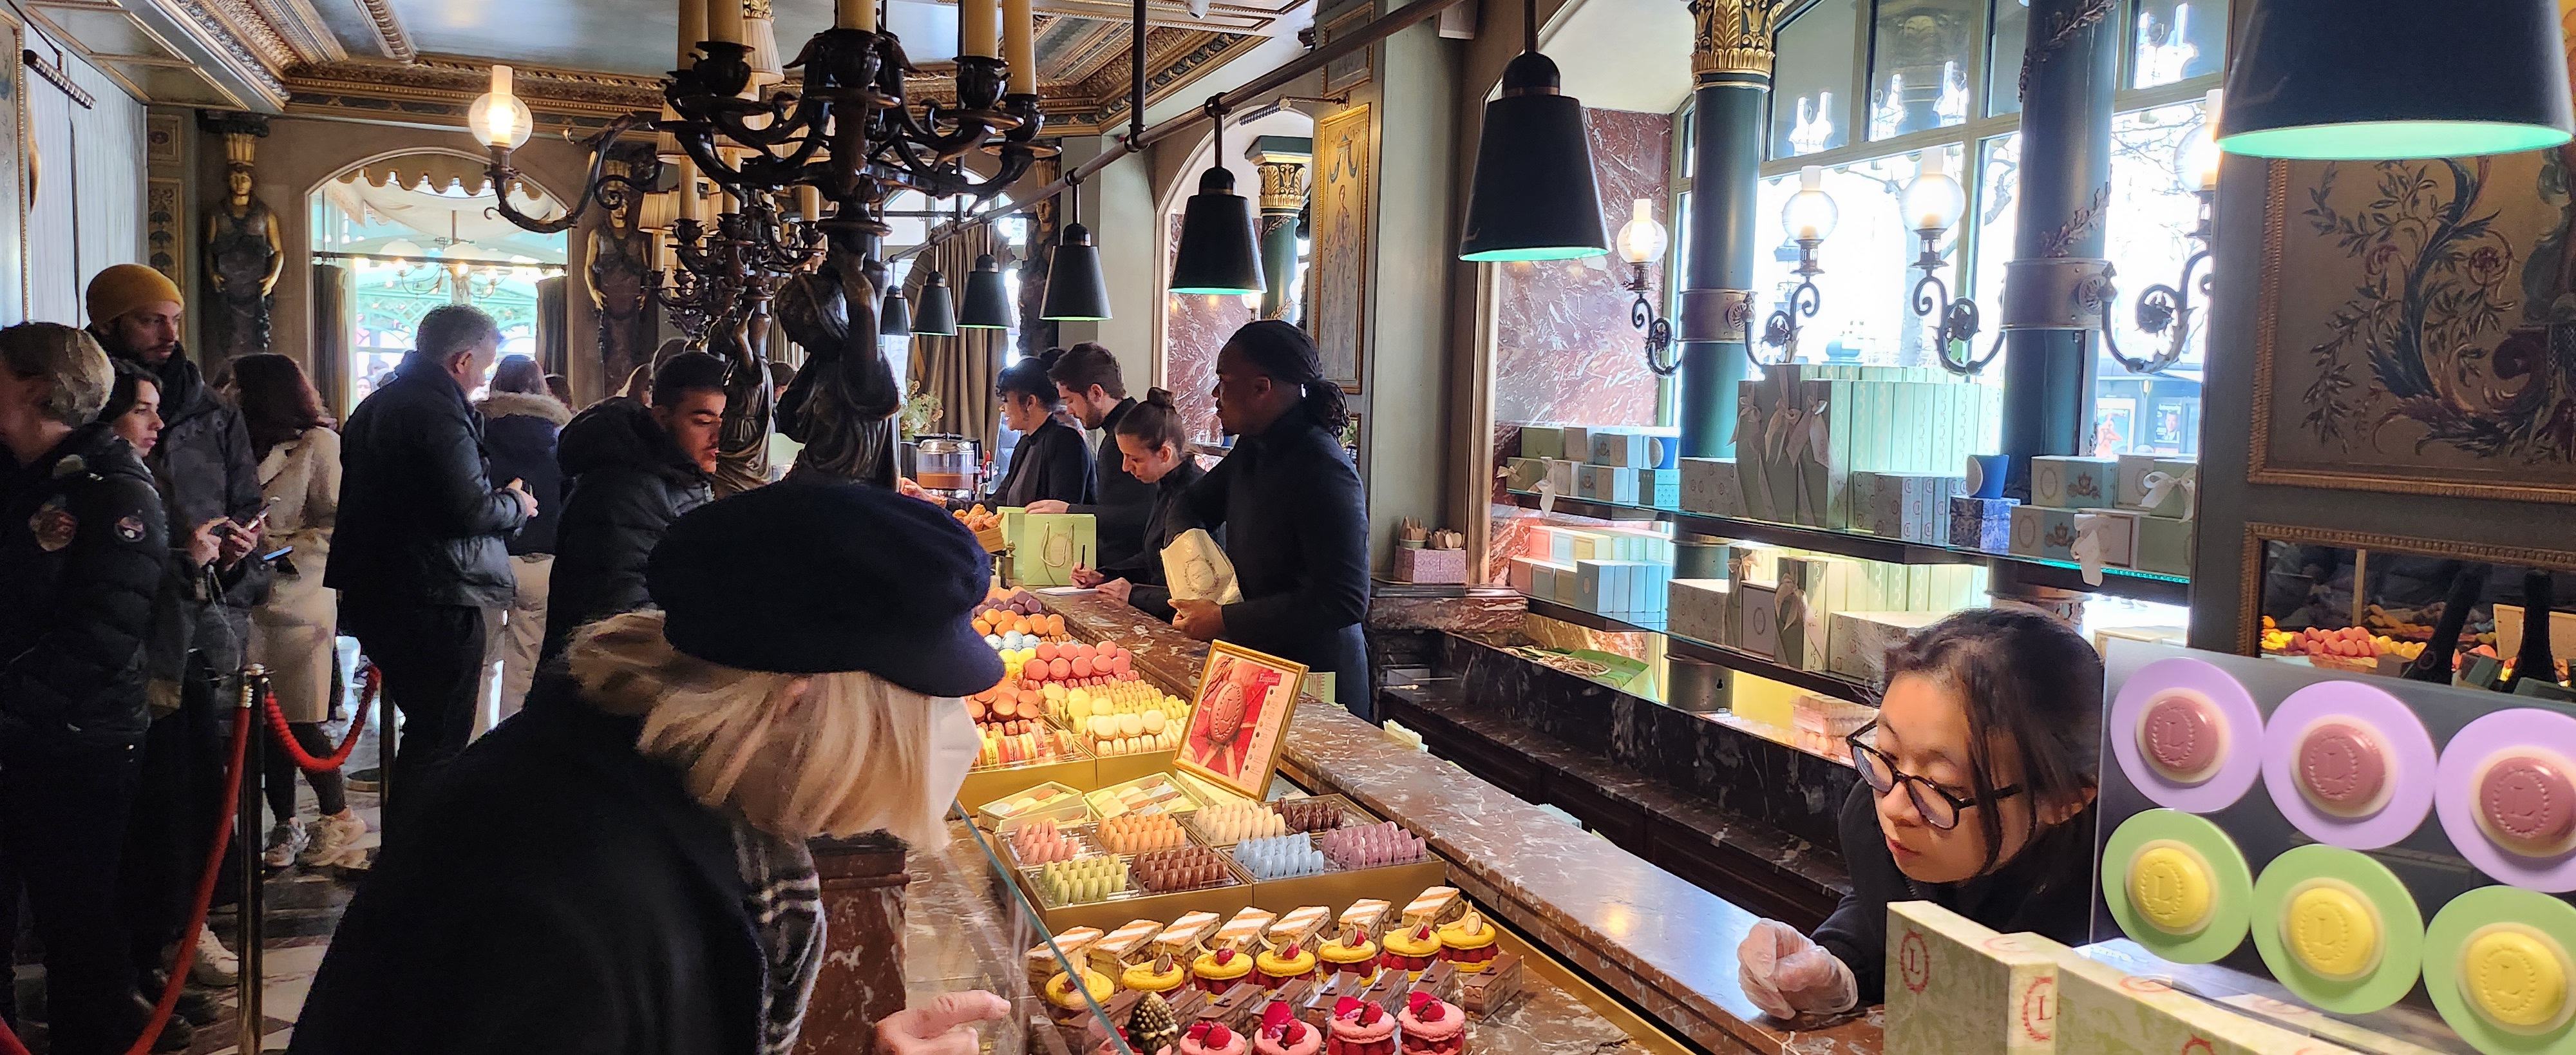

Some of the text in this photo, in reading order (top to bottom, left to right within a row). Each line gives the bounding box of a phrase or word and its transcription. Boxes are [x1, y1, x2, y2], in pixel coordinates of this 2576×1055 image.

[2164, 721, 2184, 750] L
[2322, 752, 2346, 783] L
[2509, 786, 2535, 819] L
[2152, 875, 2174, 904] L
[2312, 917, 2336, 949] L
[1908, 947, 1922, 975] L
[2496, 964, 2521, 999] L
[2035, 994, 2052, 1021] L
